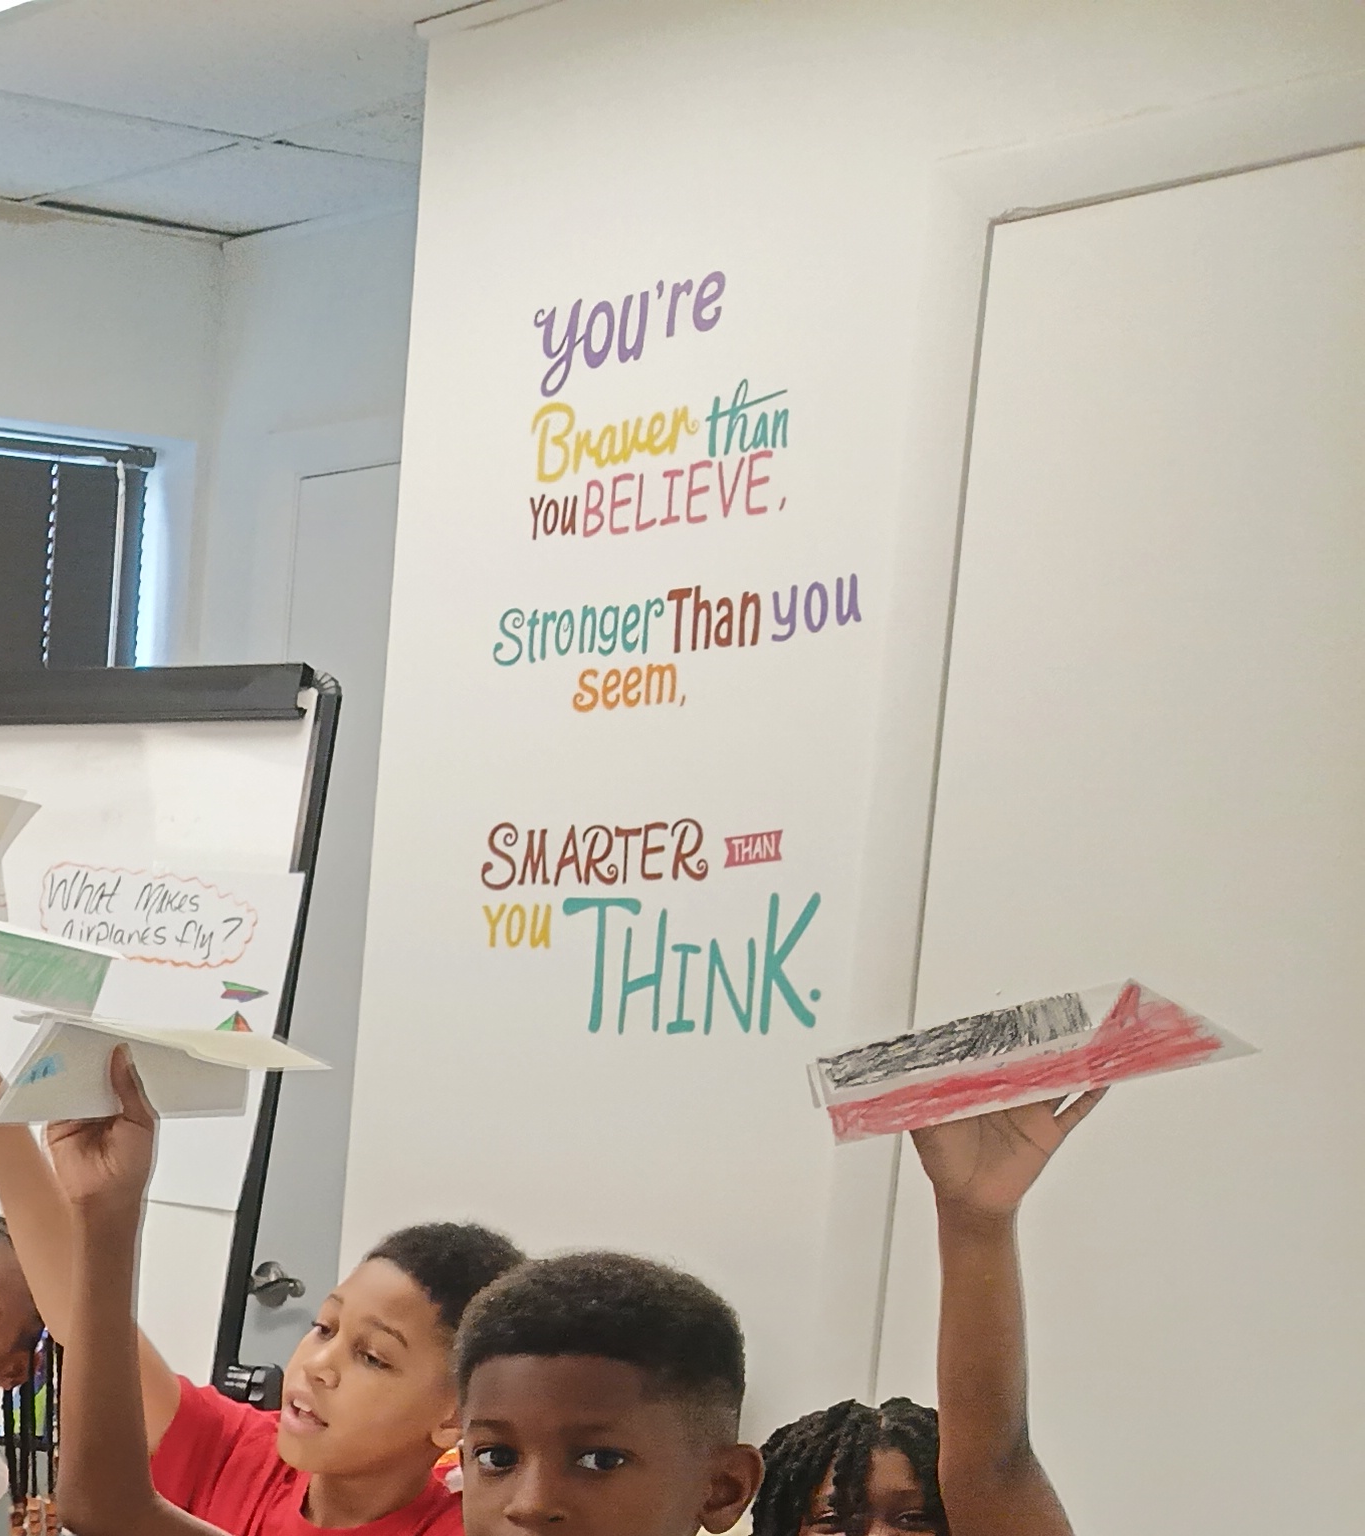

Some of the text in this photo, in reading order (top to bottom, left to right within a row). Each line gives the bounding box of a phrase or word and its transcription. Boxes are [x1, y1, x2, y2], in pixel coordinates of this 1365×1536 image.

[530, 379, 789, 483] Braver than
[583, 450, 786, 537] BELIEVE,
[493, 574, 861, 666] Stronger Than you
[573, 663, 686, 713] seem,
[48, 870, 121, 914] What
[481, 818, 777, 890] SMARTER THAN
[482, 892, 821, 1035] YOU THINK.
